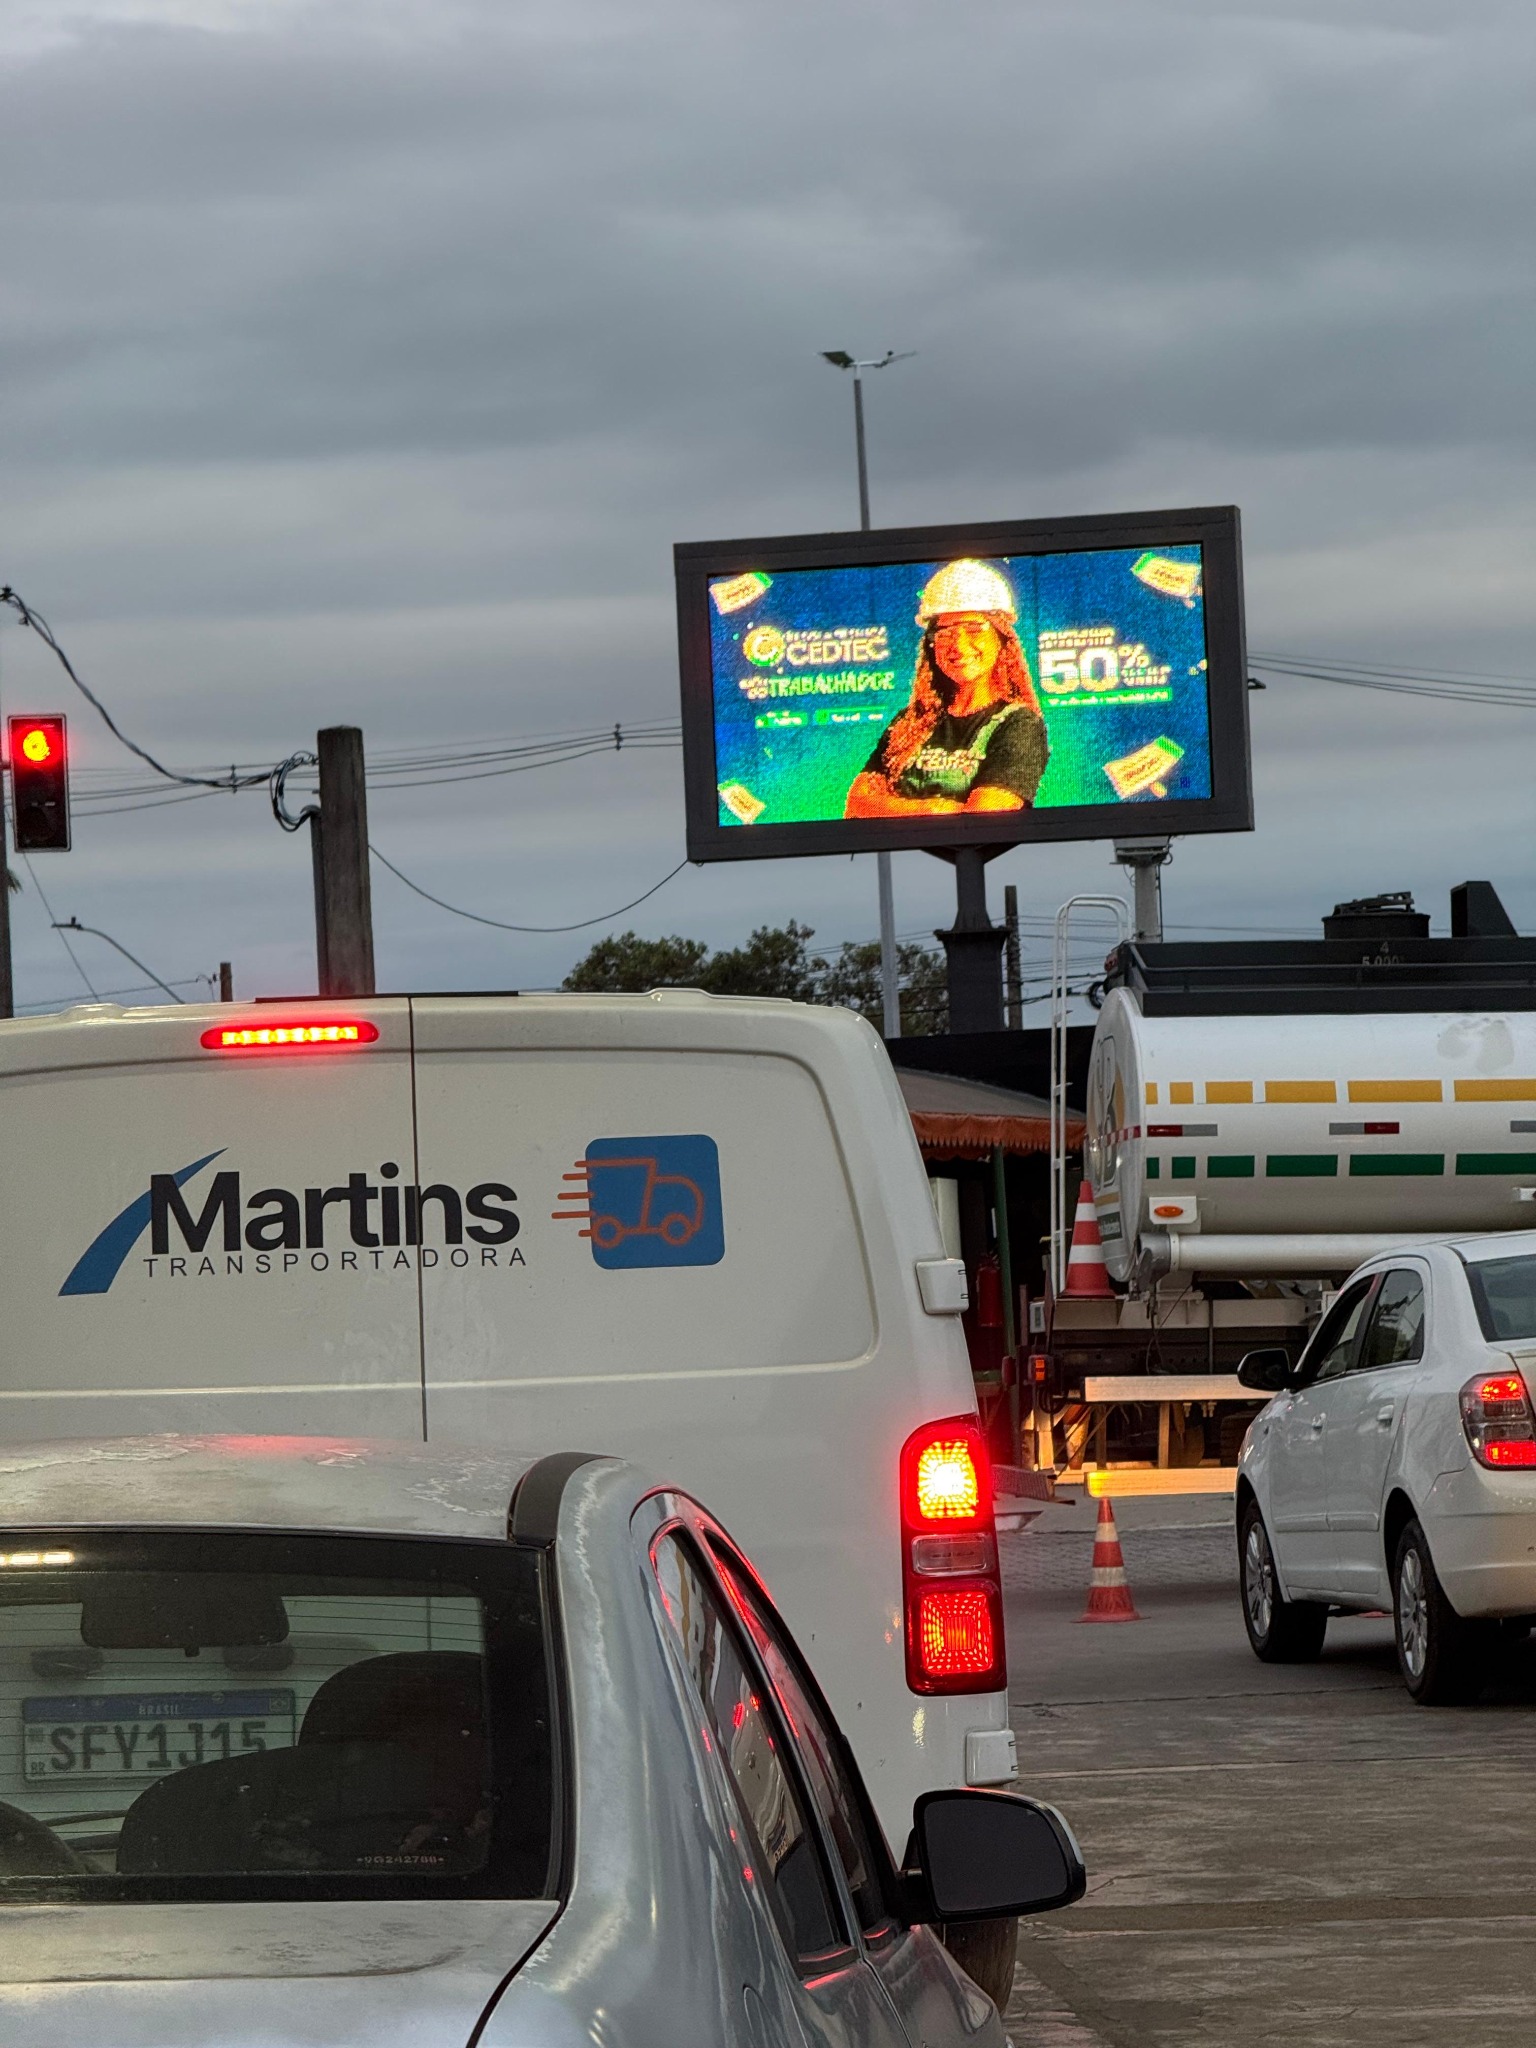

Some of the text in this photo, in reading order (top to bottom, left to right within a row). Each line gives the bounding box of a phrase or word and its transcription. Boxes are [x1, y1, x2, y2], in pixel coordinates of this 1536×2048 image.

[787, 638, 889, 666] CEDTEC
[769, 671, 894, 697] TRABALHADOR
[150, 1163, 520, 1255] Martins
[145, 1248, 527, 1278] TRANSPORTADORA
[139, 1705, 181, 1716] BRASIL
[51, 1722, 266, 1771] SFY1J15
[30, 1761, 46, 1776] BR
